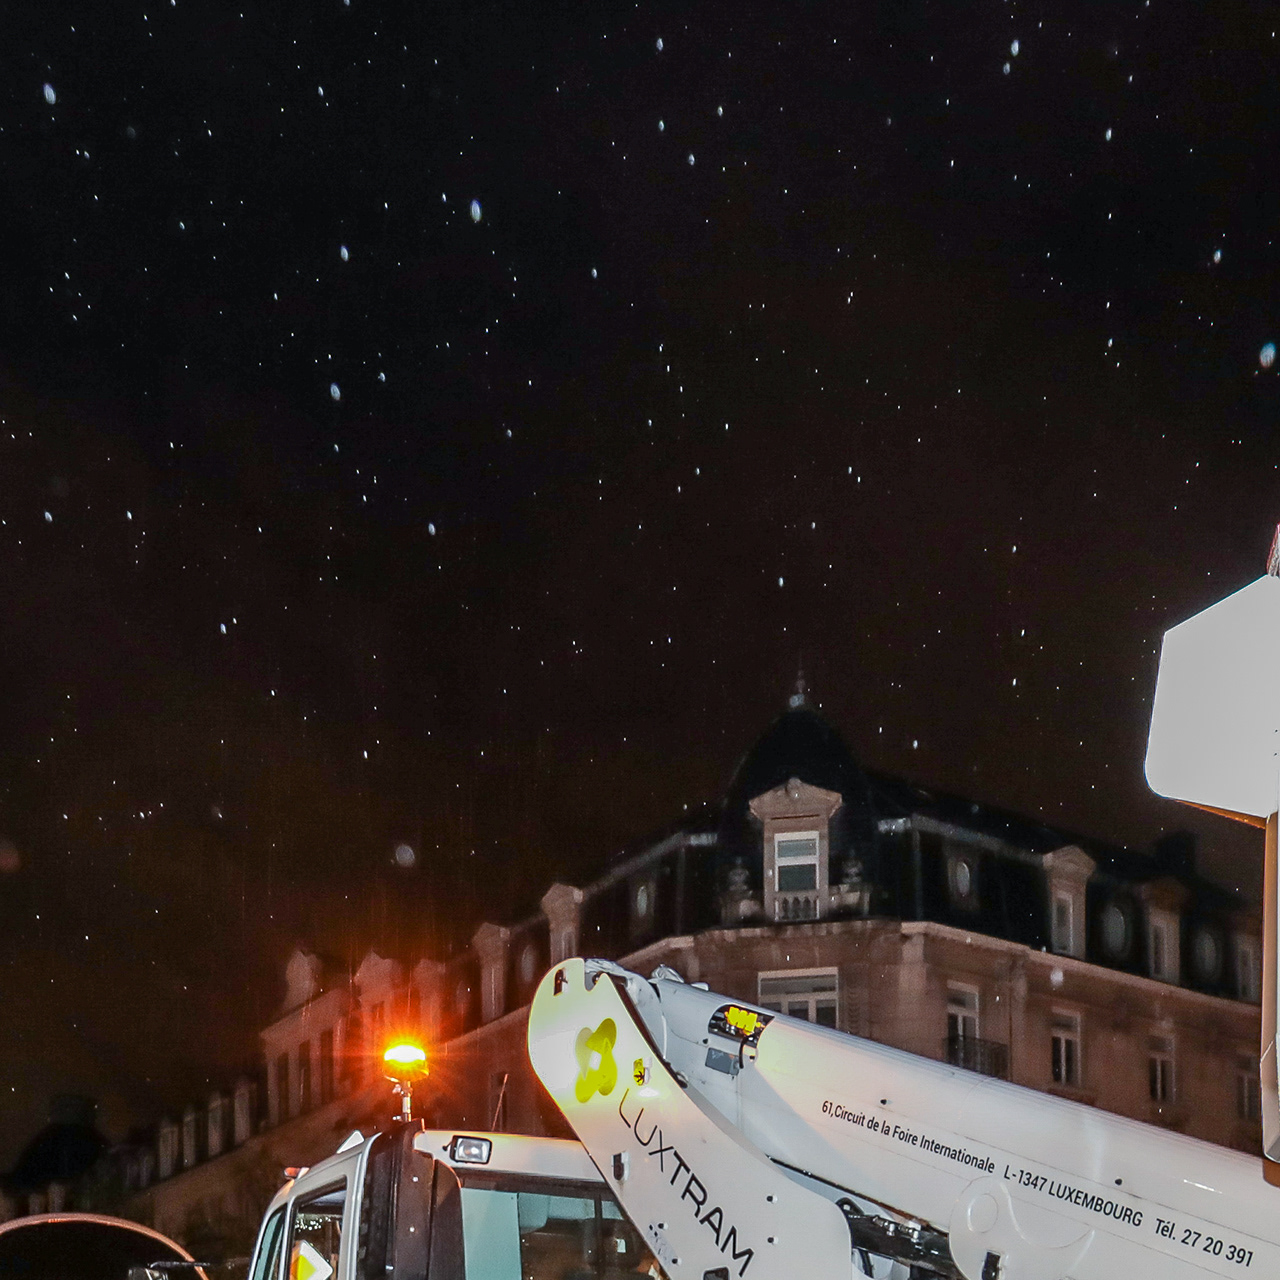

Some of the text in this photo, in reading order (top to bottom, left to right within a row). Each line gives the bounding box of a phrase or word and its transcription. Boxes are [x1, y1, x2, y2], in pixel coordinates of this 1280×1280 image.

[618, 1087, 755, 1278] LUXTRAM
[867, 1116, 879, 1131] de
[881, 1120, 891, 1136] la
[892, 1125, 919, 1146] Foire
[919, 1134, 995, 1174] Internationale
[1003, 1164, 1048, 1192] L-1347
[1048, 1180, 1144, 1227] LUXEMBOURG
[1155, 1218, 1176, 1240] Tél.
[1181, 1228, 1202, 1249] 27
[1202, 1236, 1223, 1256] 20
[1225, 1244, 1254, 1267] 391
